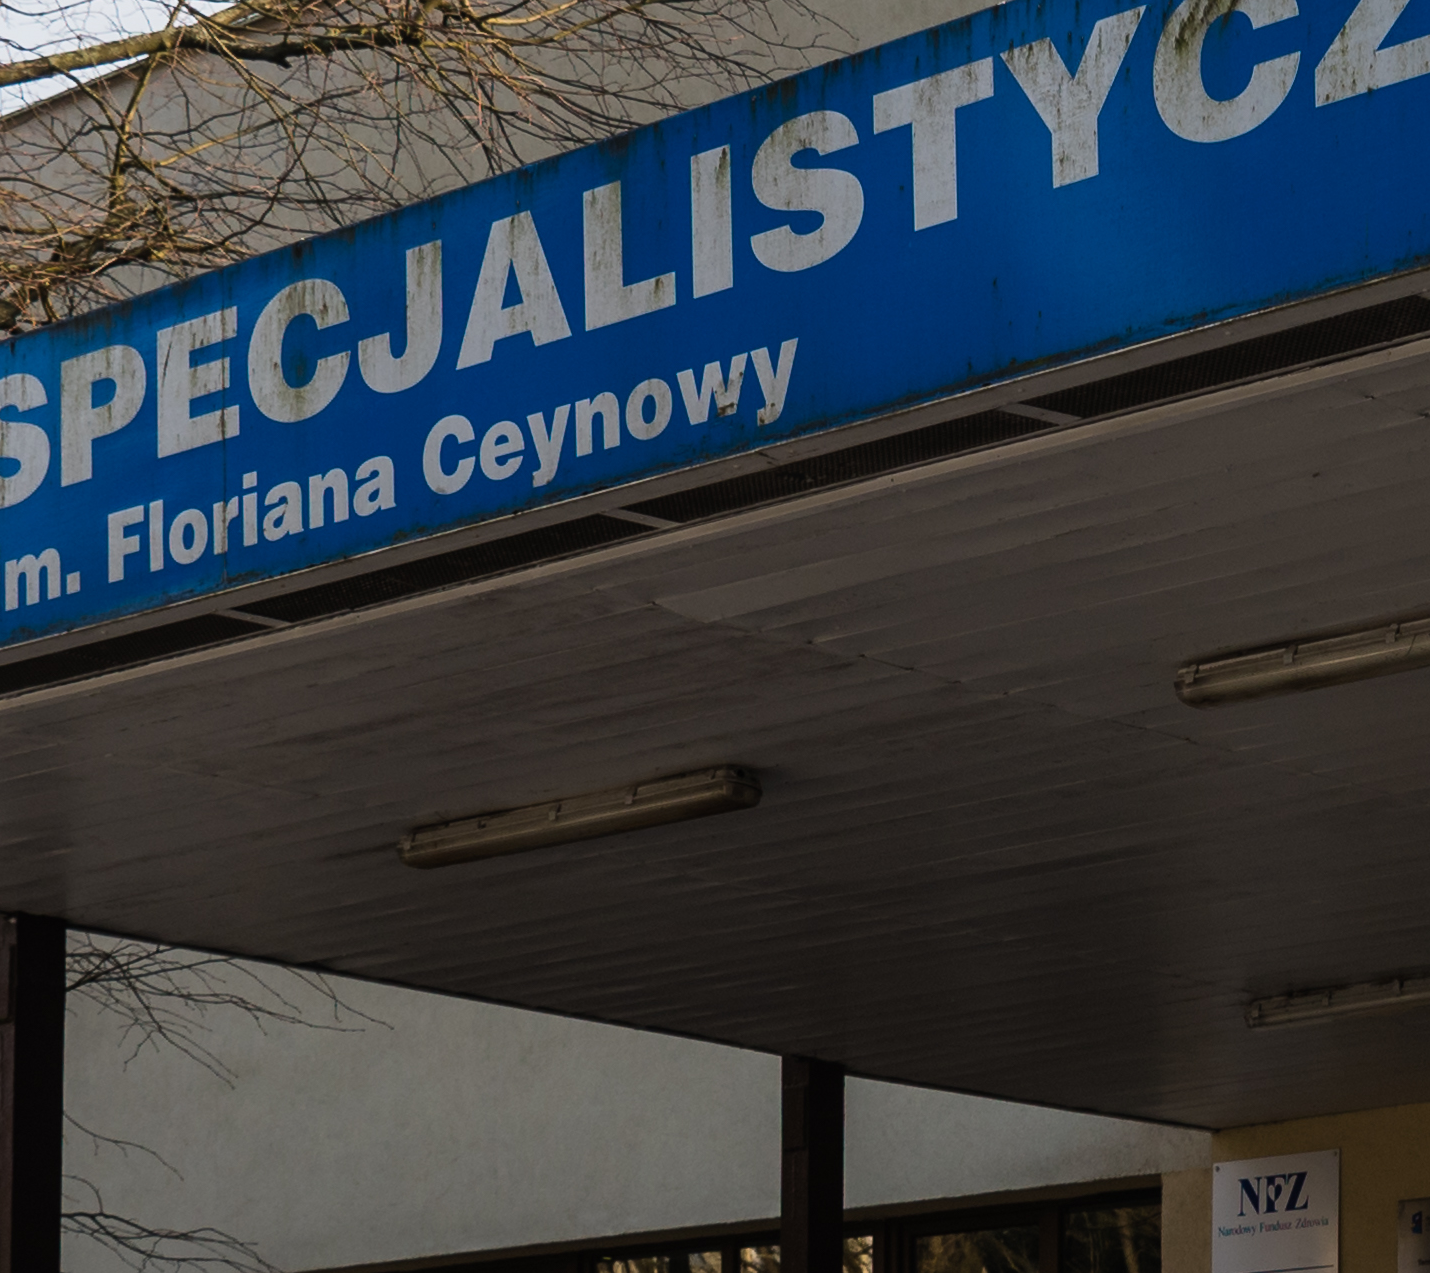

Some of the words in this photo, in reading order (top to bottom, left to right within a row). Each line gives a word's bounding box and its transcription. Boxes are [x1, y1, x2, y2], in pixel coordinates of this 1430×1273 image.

[106, 455, 396, 583] Floriana
[422, 337, 799, 495] Ceynowy
[1238, 1171, 1309, 1217] NFZ
[1218, 1225, 1256, 1238] Narodowy
[1259, 1220, 1292, 1233] Fundusz
[1295, 1215, 1329, 1229] Zdrowia
